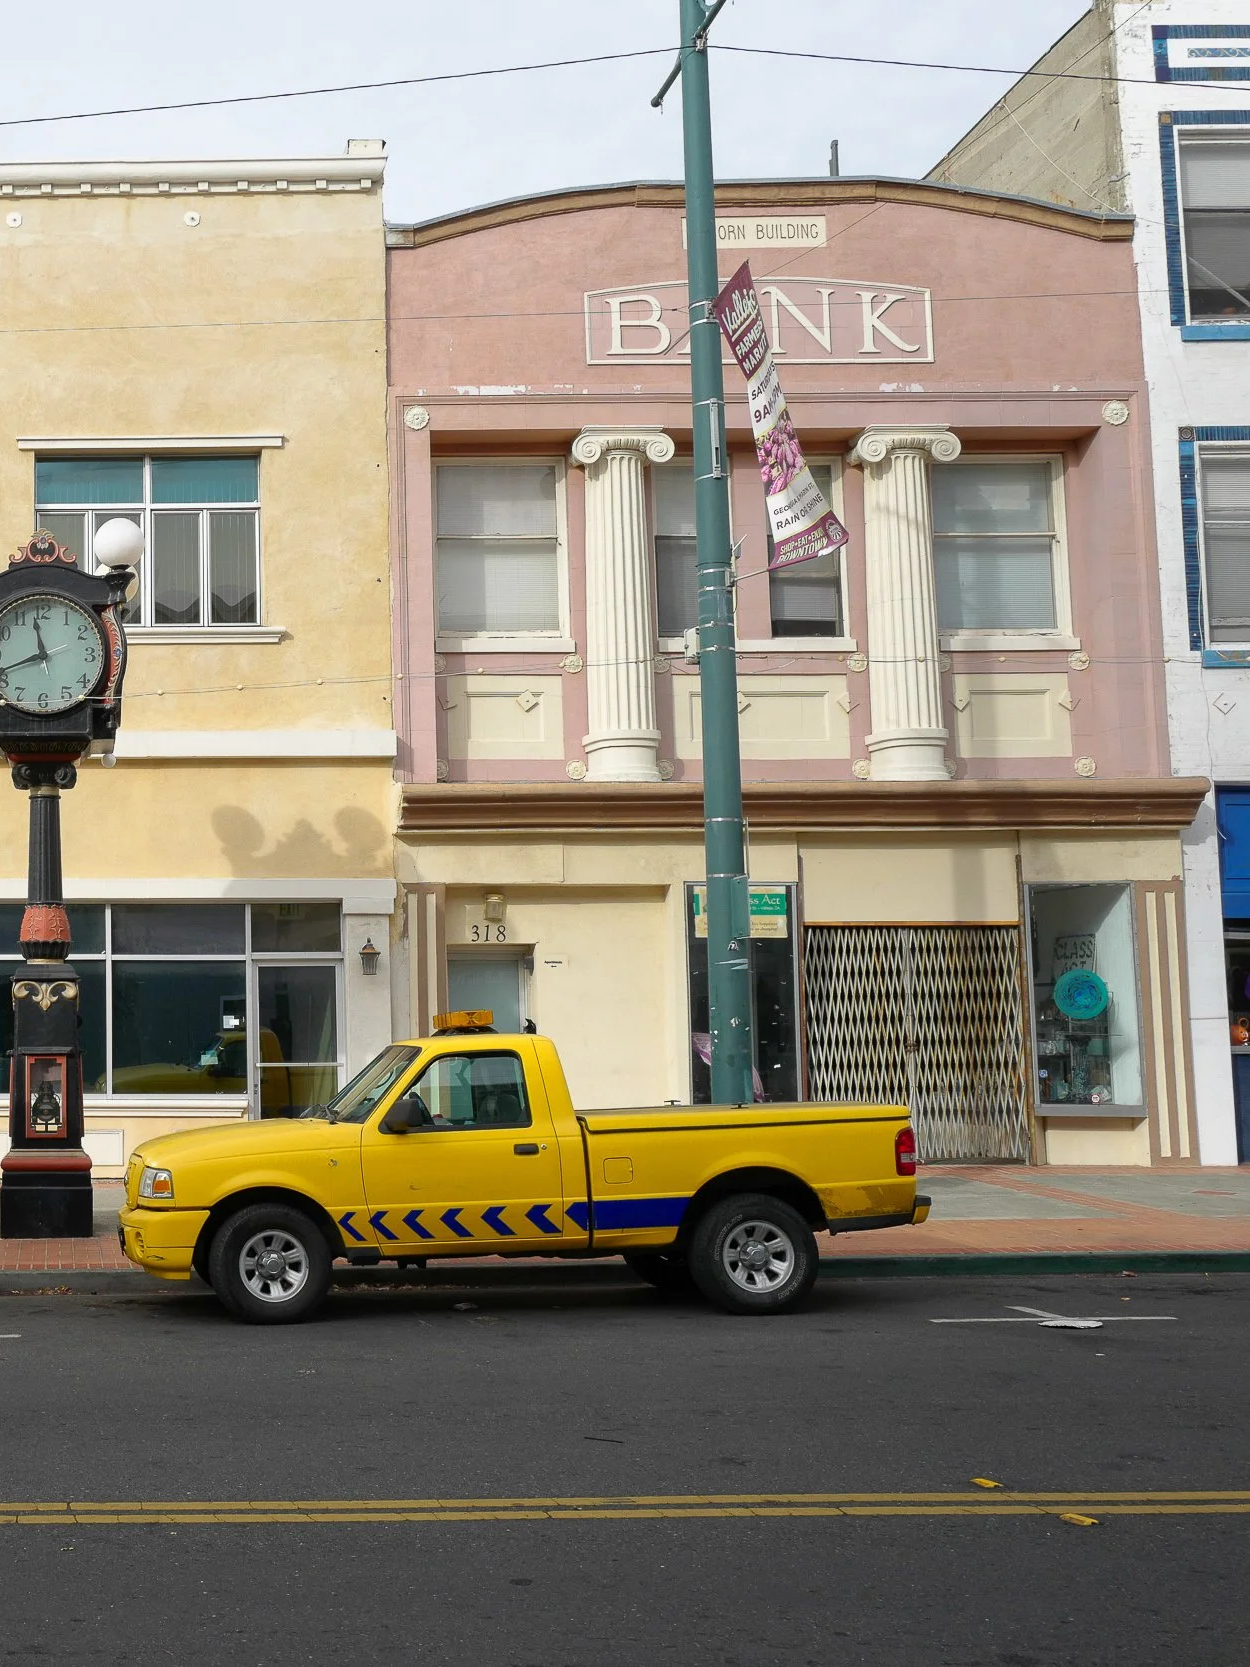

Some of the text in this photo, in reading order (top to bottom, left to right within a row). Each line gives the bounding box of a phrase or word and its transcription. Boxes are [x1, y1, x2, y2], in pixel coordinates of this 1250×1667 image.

[717, 223, 819, 240] ORN BUILDING
[605, 286, 921, 356] BNK
[776, 492, 824, 530] RAIN OR SHINE
[776, 535, 828, 564] DOWNTOWN
[13, 611, 27, 626] 11
[36, 604, 51, 620] 12
[63, 610, 69, 626] 1
[77, 624, 88, 641] 2
[84, 646, 96, 663] 3
[76, 673, 91, 689] 4
[14, 686, 27, 702] 7
[37, 692, 49, 708] 6
[61, 686, 73, 701] 5
[761, 893, 781, 905] Act
[471, 925, 506, 942] 318
[1054, 940, 1093, 960] CLASS
